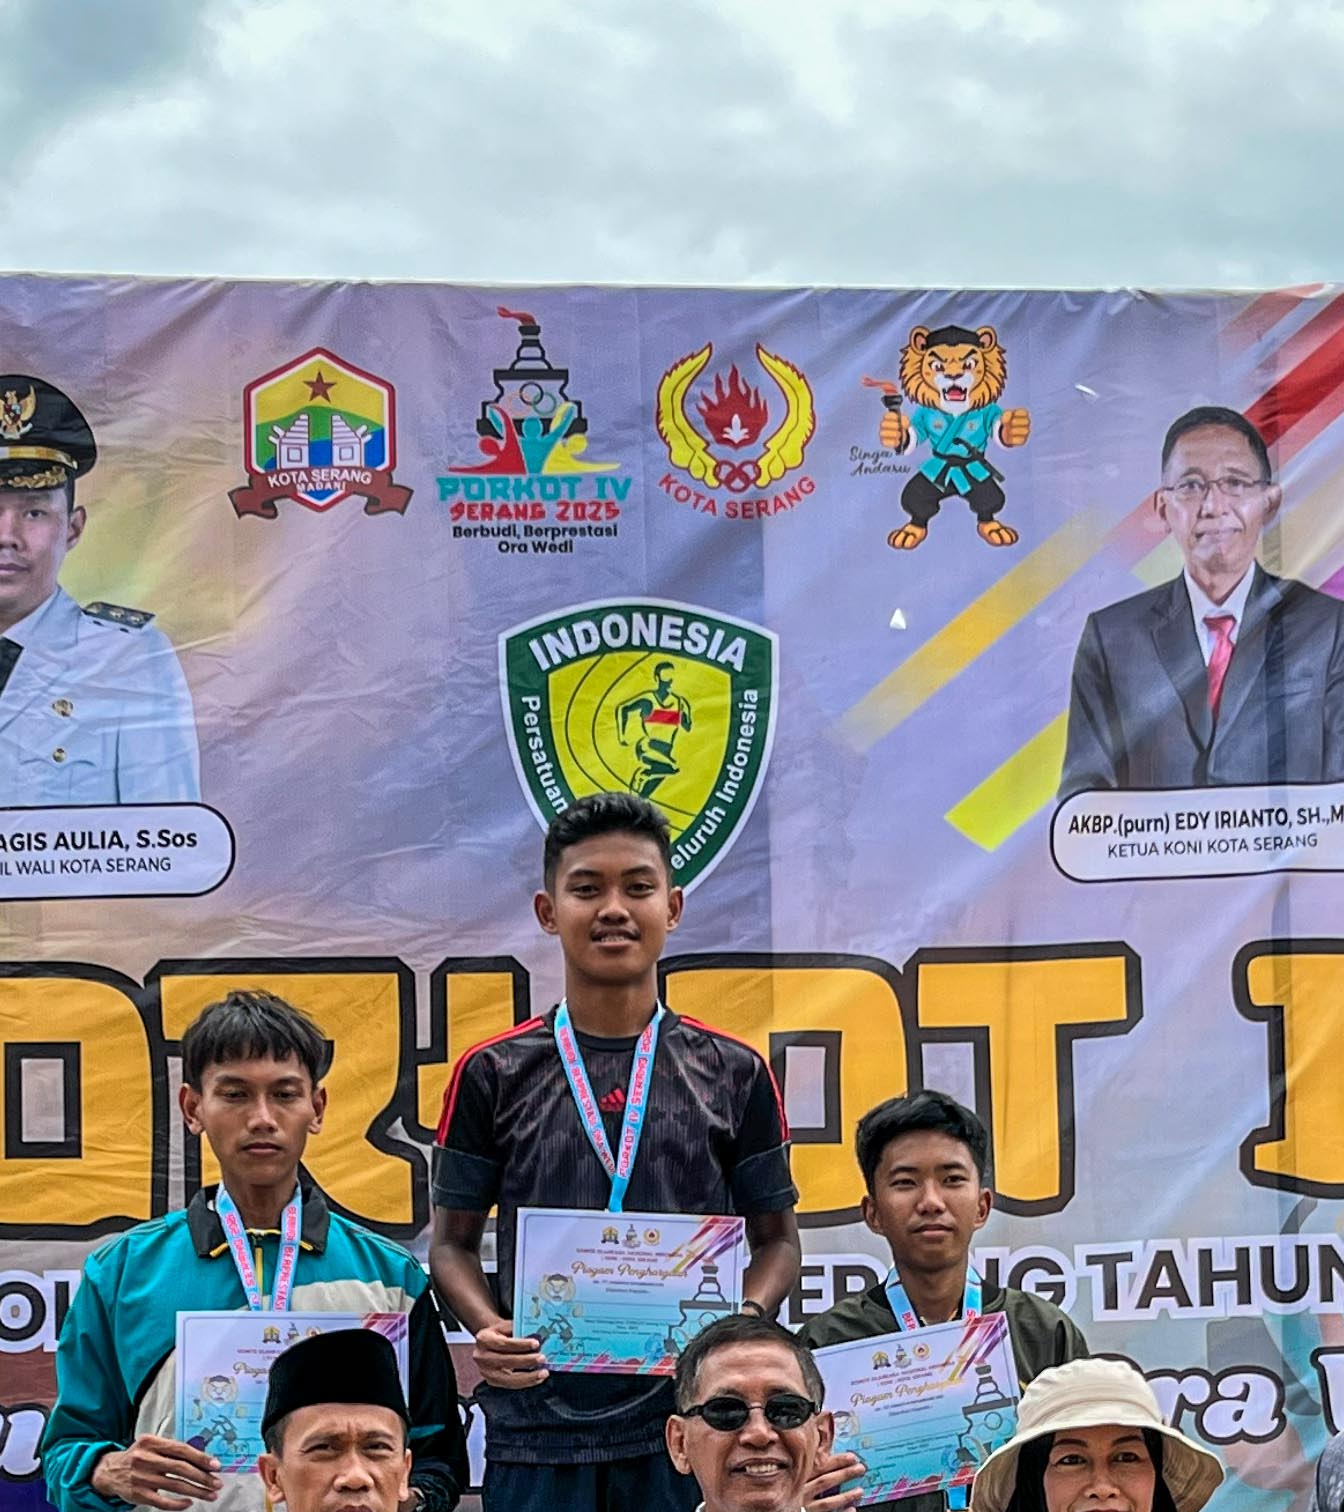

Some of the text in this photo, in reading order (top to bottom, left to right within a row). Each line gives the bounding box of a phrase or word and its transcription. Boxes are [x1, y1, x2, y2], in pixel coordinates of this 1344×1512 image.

[267, 469, 373, 488] KOTA SERANG
[436, 476, 633, 501] PORKOT IV
[658, 473, 816, 520] KOTA SERANG
[450, 501, 621, 522] SERANG 2025
[453, 524, 618, 541] Berbudi, Berprestasi
[498, 540, 574, 554] Ora Wedi
[528, 612, 747, 673] INDONESIA
[521, 695, 569, 815] Persatuan
[670, 689, 759, 871] eluruh Indonesia
[1068, 813, 1170, 837] AKBP.(purn)
[1176, 811, 1210, 831] EDY
[1214, 809, 1293, 832] IRIANTO,
[54, 831, 129, 855] AULIA,
[136, 829, 197, 851] S.Sos
[1108, 834, 1318, 858] KETUA KONI KOTA SERANG
[16, 860, 55, 877] WALI
[59, 858, 102, 876] KOTA
[106, 856, 171, 875] SERANG
